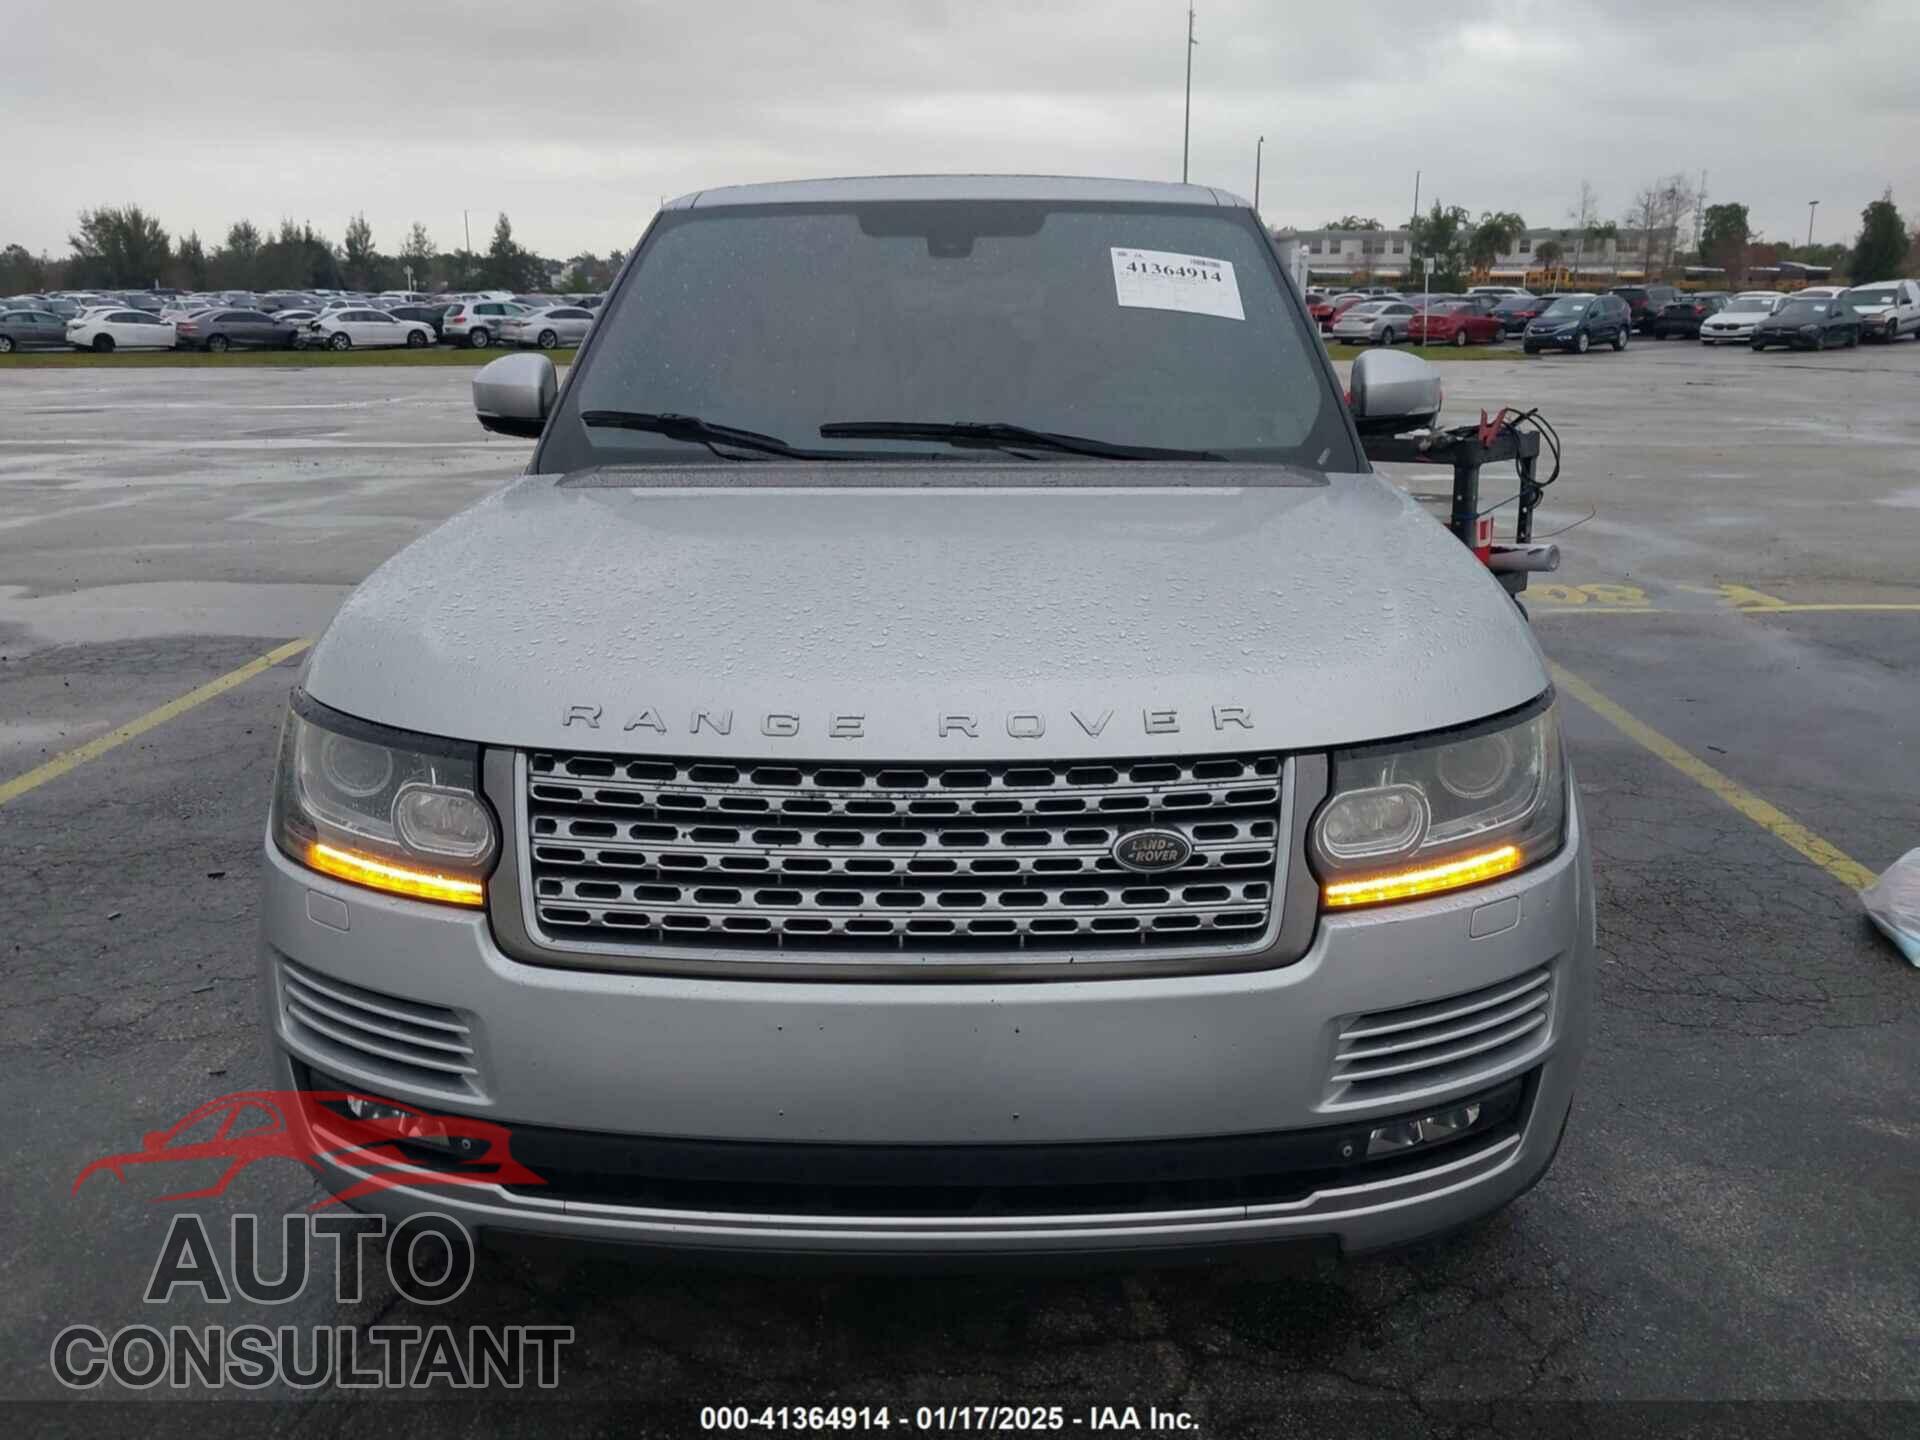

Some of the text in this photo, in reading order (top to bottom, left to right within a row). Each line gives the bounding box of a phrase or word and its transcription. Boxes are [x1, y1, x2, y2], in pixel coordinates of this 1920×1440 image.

[1126, 261, 1222, 283] 41364914
[562, 703, 1255, 738] RANGE ROVER
[1132, 839, 1168, 850] LAND
[1136, 849, 1178, 861] ROVER
